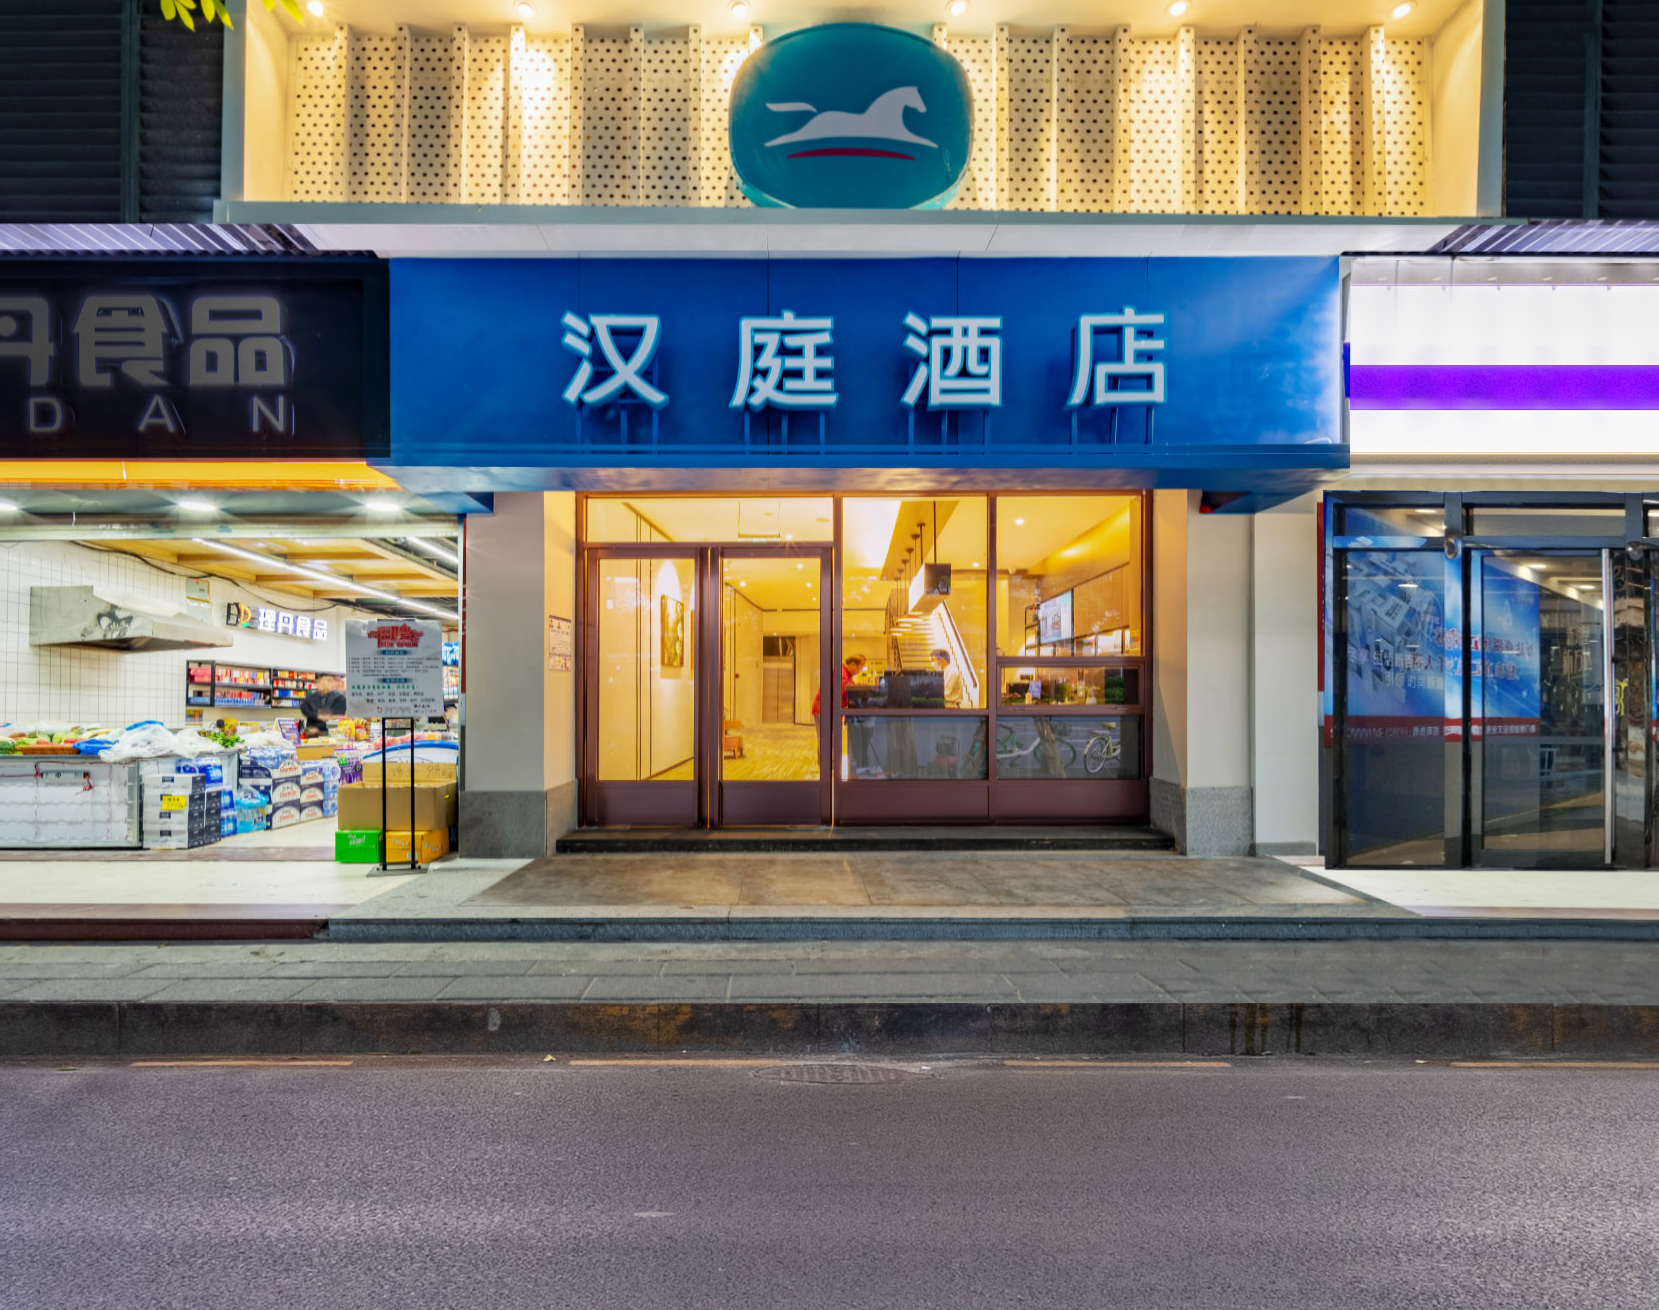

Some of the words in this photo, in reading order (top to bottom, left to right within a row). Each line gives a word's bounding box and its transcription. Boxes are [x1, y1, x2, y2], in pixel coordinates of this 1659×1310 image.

[560, 306, 1167, 409] 汉庭酒店
[257, 607, 328, 641] 理丹食品
